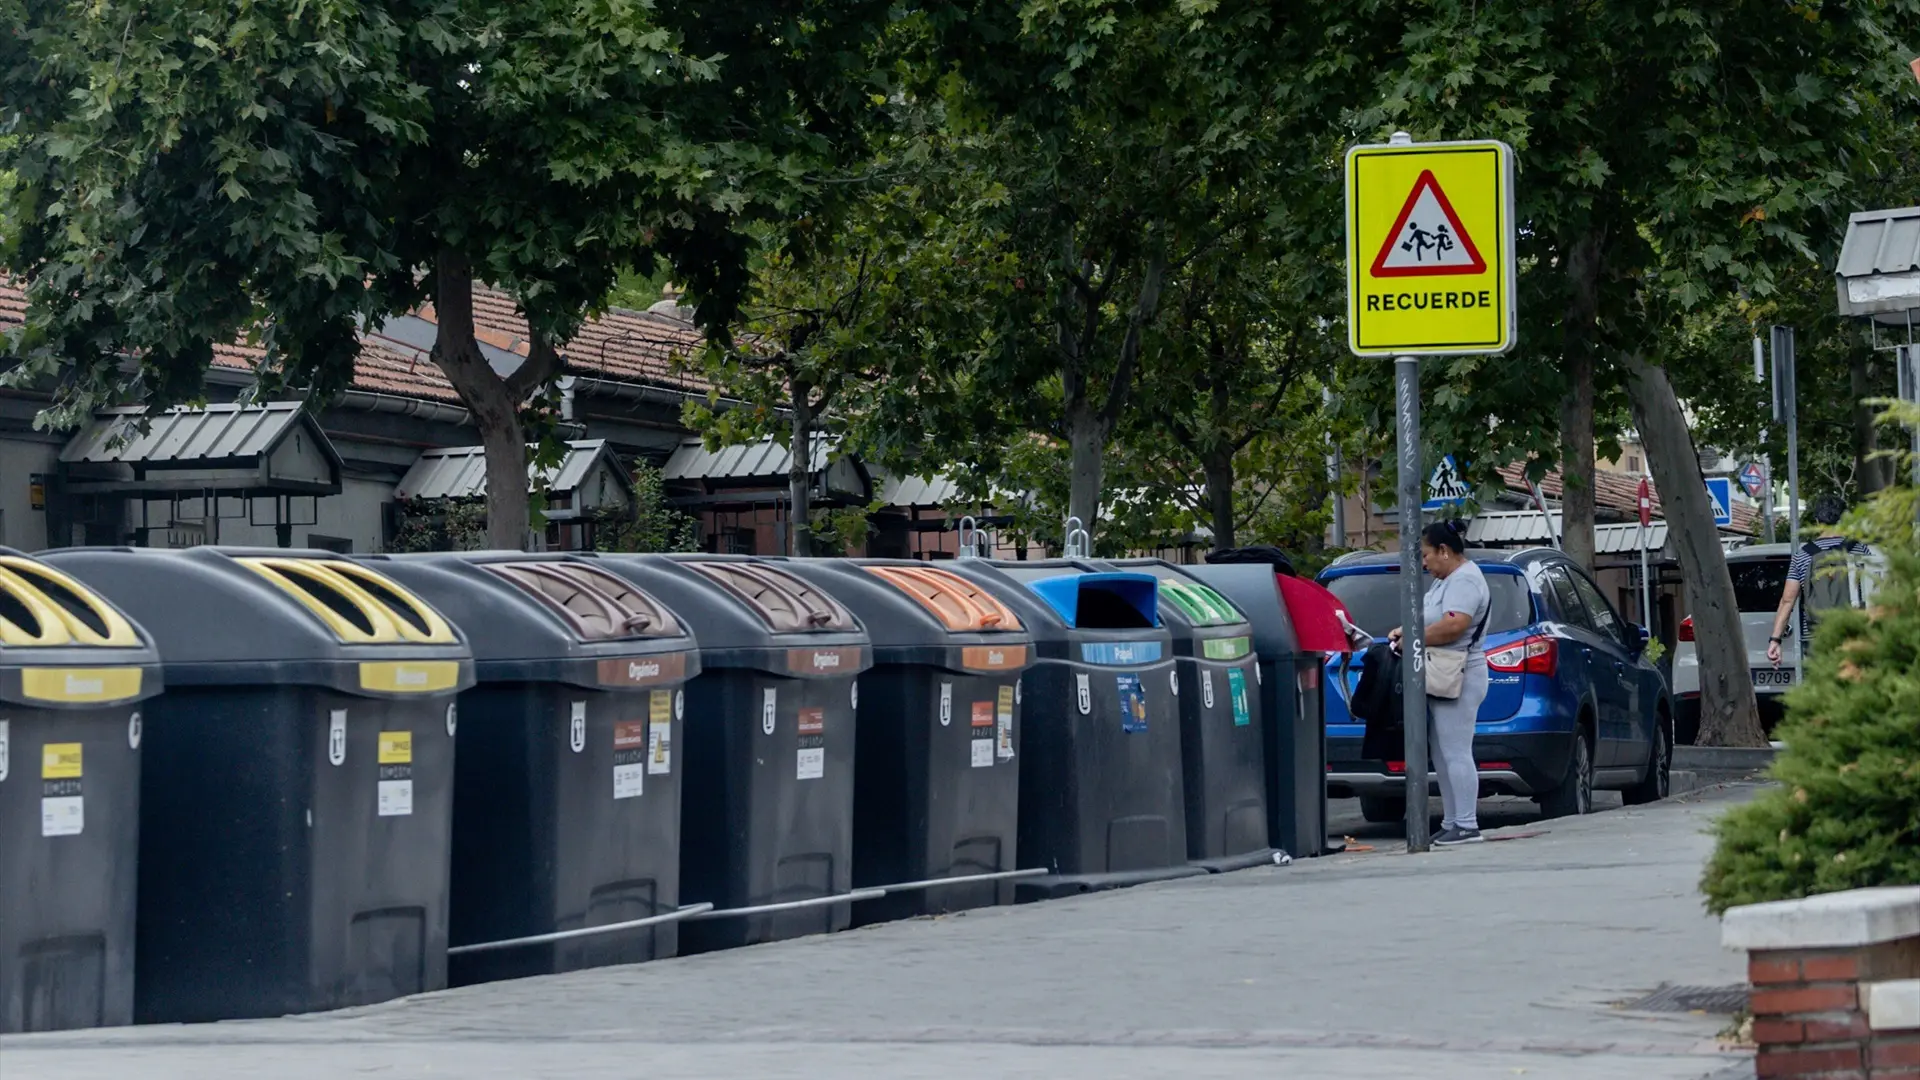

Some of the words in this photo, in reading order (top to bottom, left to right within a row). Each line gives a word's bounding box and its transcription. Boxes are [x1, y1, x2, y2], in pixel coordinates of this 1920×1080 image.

[1367, 290, 1491, 312] RECUERDE
[628, 660, 660, 681] Orgánica
[813, 651, 840, 670] Orgánica
[1758, 672, 1791, 684] 9709
